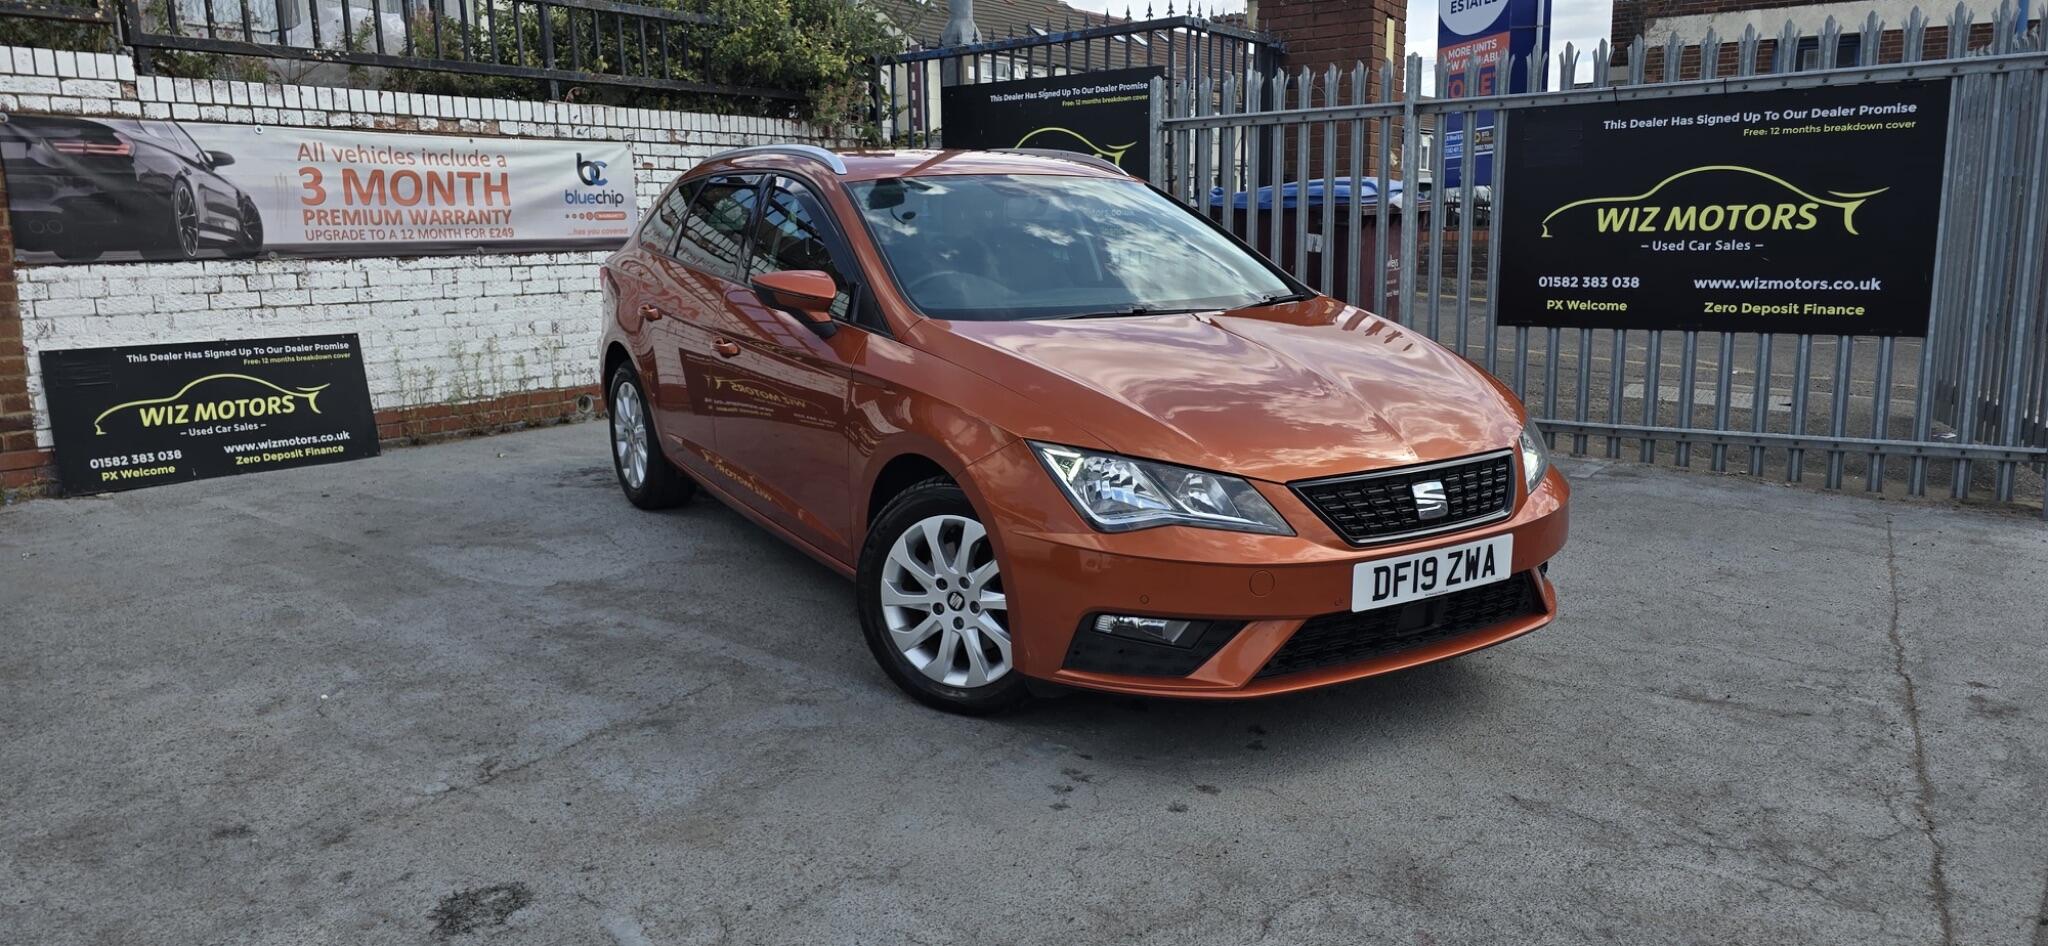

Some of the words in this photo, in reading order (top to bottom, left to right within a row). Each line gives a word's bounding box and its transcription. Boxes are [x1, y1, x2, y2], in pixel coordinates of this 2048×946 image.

[1448, 46, 1471, 59] MORE
[1472, 39, 1496, 52] UNITS
[1004, 93, 1024, 101] Dealer
[1038, 90, 1061, 100] Signed
[1062, 88, 1071, 97] Up
[1081, 86, 1094, 94] Our
[1095, 84, 1117, 93] Dealer
[1118, 82, 1148, 90] Promise
[1603, 119, 1627, 130] This
[1630, 117, 1668, 129] Dealer
[1671, 115, 1694, 126] Has
[1696, 112, 1740, 128] Signed
[1743, 112, 1761, 125] Up
[1764, 110, 1780, 122] To
[1783, 108, 1807, 120] Our
[1811, 106, 1856, 118] Dealer
[1859, 102, 1917, 116] Promise
[1743, 128, 1767, 136] Free:
[1770, 127, 1780, 135] 12
[1782, 125, 1821, 134] months
[1823, 122, 1883, 133] breakdown
[1885, 121, 1916, 130] cover
[297, 142, 326, 162] All
[330, 145, 416, 165] vehicles
[422, 148, 490, 168] include
[496, 152, 507, 168] a
[298, 166, 327, 206] 3
[342, 168, 511, 207] MONTH
[564, 189, 624, 207] bluechip
[302, 208, 403, 226] PREMIUM
[408, 209, 512, 226] WARRANTY
[1597, 206, 1659, 232] WIZ
[1664, 202, 1819, 232] MOTORS
[304, 228, 366, 242] UPGRADE
[368, 229, 386, 241] TO
[389, 229, 398, 240] A
[400, 228, 414, 240] 12
[418, 228, 462, 239] MONTH
[464, 228, 485, 238] FOR
[489, 228, 514, 238] £249
[1652, 240, 1685, 251] Used
[1688, 240, 1711, 251] Car
[1714, 239, 1751, 251] Sales
[1538, 276, 1579, 288] 01582
[1582, 276, 1608, 289] 383
[1611, 276, 1640, 289] 038
[1694, 277, 1882, 292] www.wizmotors.co.uk
[1546, 300, 1564, 310] PX
[1566, 300, 1628, 312] Welcome
[1704, 302, 1738, 314] Zero
[1741, 302, 1799, 317] Deposit
[1803, 303, 1865, 316] Finance
[126, 354, 148, 364] This
[150, 352, 182, 362] Dealer
[184, 350, 202, 360] Has
[204, 348, 237, 360] Signed
[239, 347, 252, 357] Up
[254, 346, 265, 355] To
[266, 345, 283, 354] Our
[285, 343, 313, 353] Dealer
[315, 341, 350, 351] Promise
[270, 355, 295, 364] months
[296, 353, 332, 362] breakdown
[334, 352, 350, 360] cover
[140, 404, 189, 428] WIZ
[194, 395, 296, 423] MOTORS
[189, 427, 214, 437] Used
[215, 425, 232, 434] Car
[234, 422, 259, 432] Sales
[224, 430, 350, 454] www.wizmotors.co.uk
[90, 456, 128, 470] 01582
[131, 453, 155, 465] 383
[158, 450, 182, 462] 038
[235, 454, 261, 466] Zero
[263, 450, 303, 464] Deposit
[305, 445, 344, 457] Finance
[101, 470, 119, 482] PX
[120, 464, 176, 479] Welcome
[1372, 556, 1438, 602] DF19
[1446, 544, 1496, 586] ZWA
